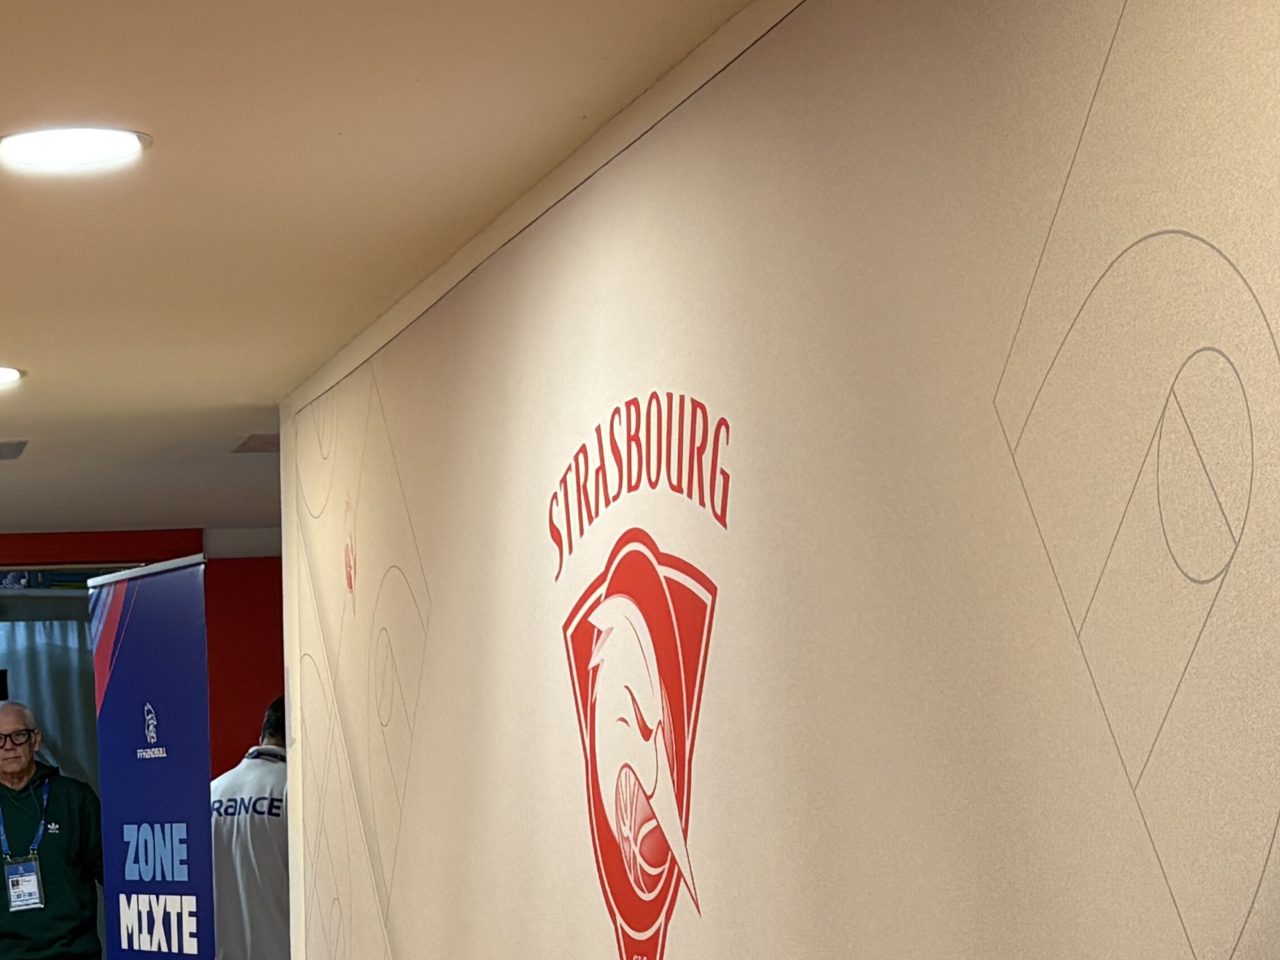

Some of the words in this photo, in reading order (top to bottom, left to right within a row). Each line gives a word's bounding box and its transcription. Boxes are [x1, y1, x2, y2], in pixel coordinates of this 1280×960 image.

[548, 390, 730, 583] STRASBOURG
[123, 823, 189, 882] ZONE
[119, 893, 198, 955] MIXTE
